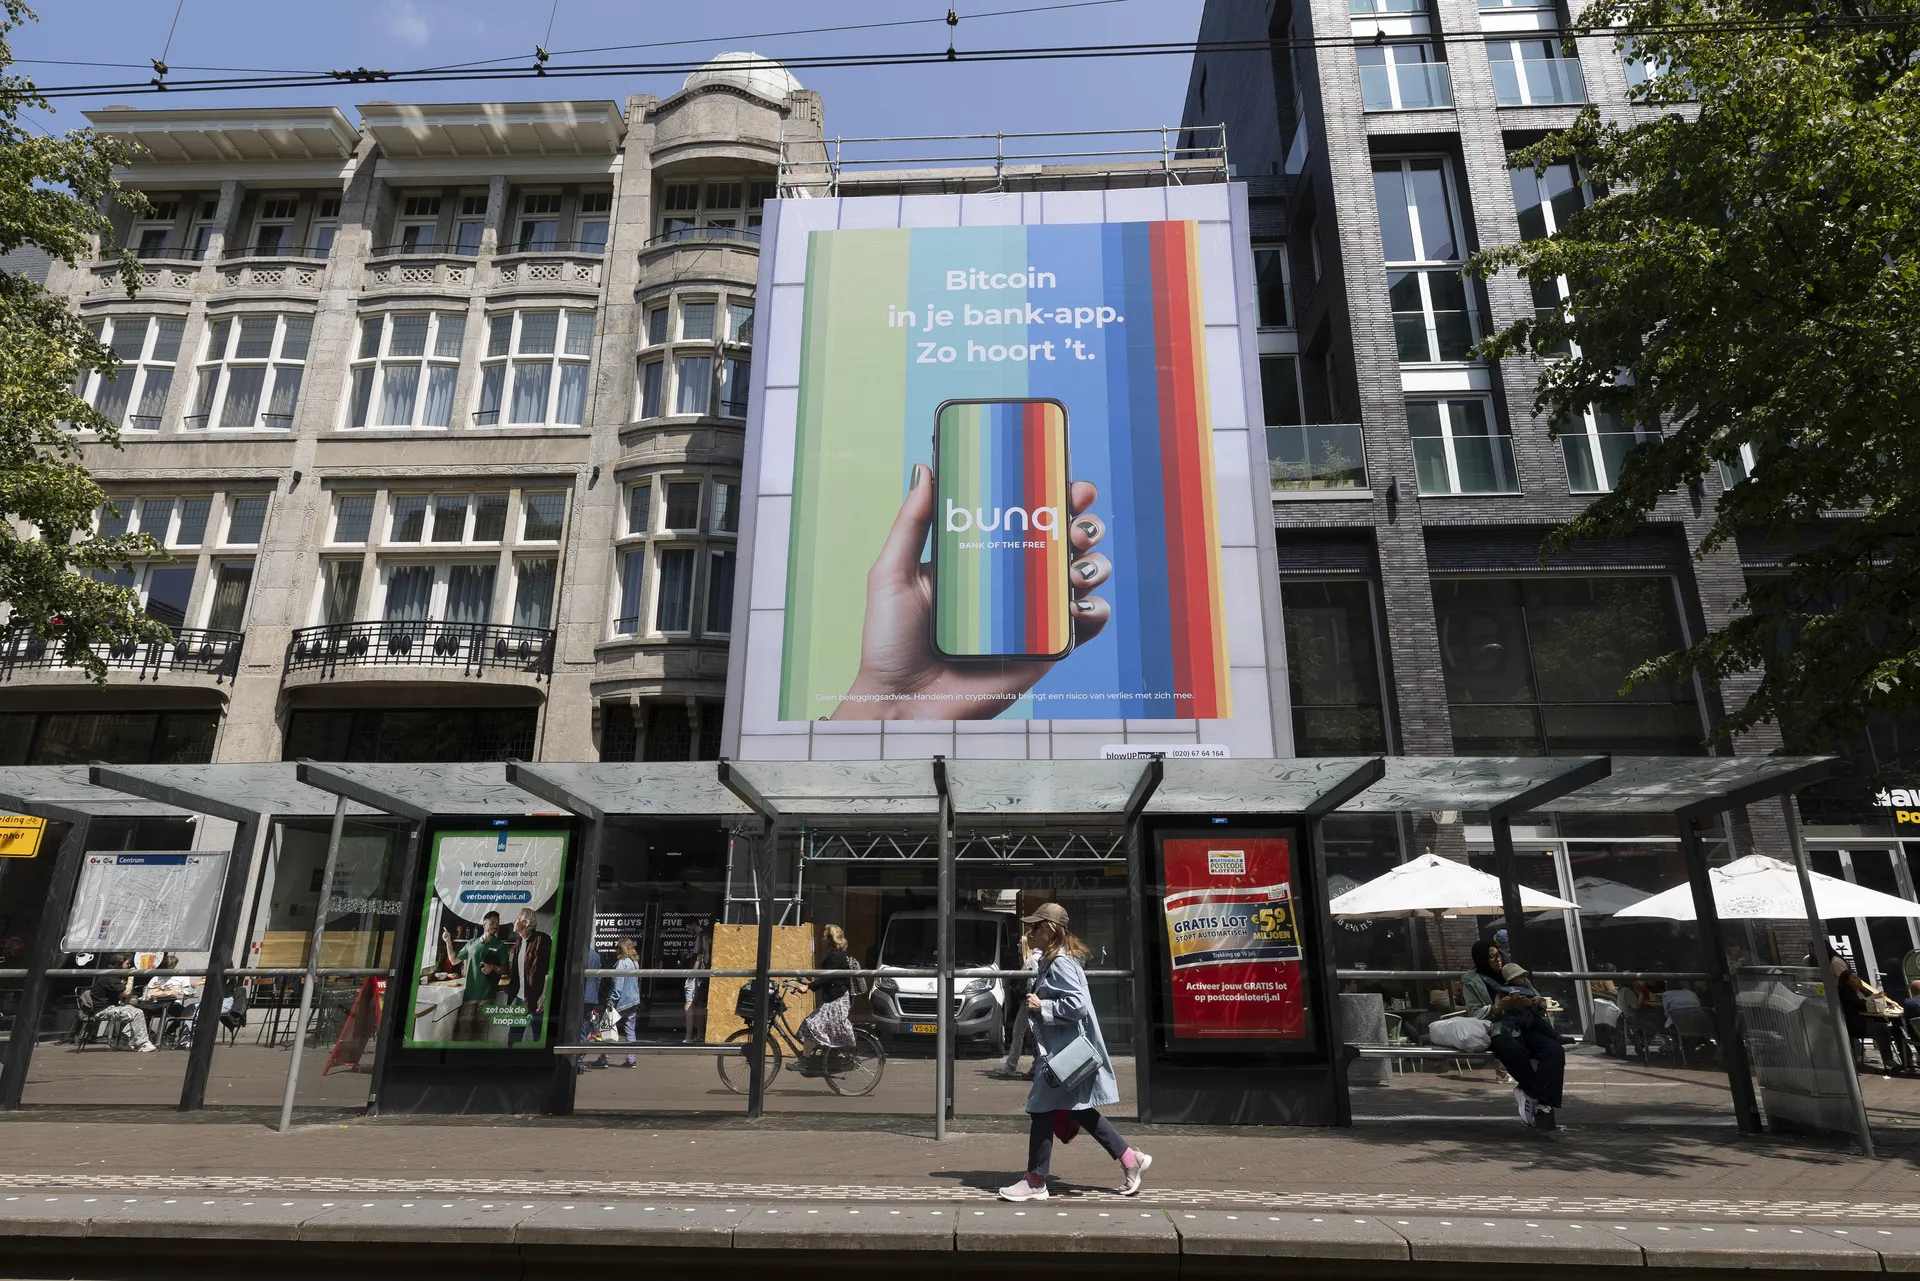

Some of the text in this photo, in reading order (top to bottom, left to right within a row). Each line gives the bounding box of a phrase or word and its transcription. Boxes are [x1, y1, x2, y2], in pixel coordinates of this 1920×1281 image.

[946, 266, 1056, 290] Bitcoin
[888, 303, 1124, 332] in je bank-app.
[916, 342, 957, 363] Zo
[968, 340, 1056, 362] hoort
[947, 499, 1058, 540] bunq
[815, 693, 836, 701] Geen
[839, 693, 911, 702] beleggingsadvies.
[965, 693, 1016, 702] cryptovaluta
[1018, 693, 1046, 701] brengt
[1066, 692, 1088, 700] risico
[1107, 692, 1133, 700] verlies
[475, 870, 518, 878] energieloket
[520, 870, 538, 878] helpt
[466, 893, 526, 901] verbeterjehuis.nl
[1174, 917, 1247, 933] GRATIS LOT
[1176, 929, 1247, 942] STOPT AUTOMATISCH
[1254, 931, 1290, 940] MILJOEN
[1221, 983, 1241, 991] jouw
[1208, 994, 1280, 1003] postcodeloterij.nl
[493, 1017, 513, 1026] knop
